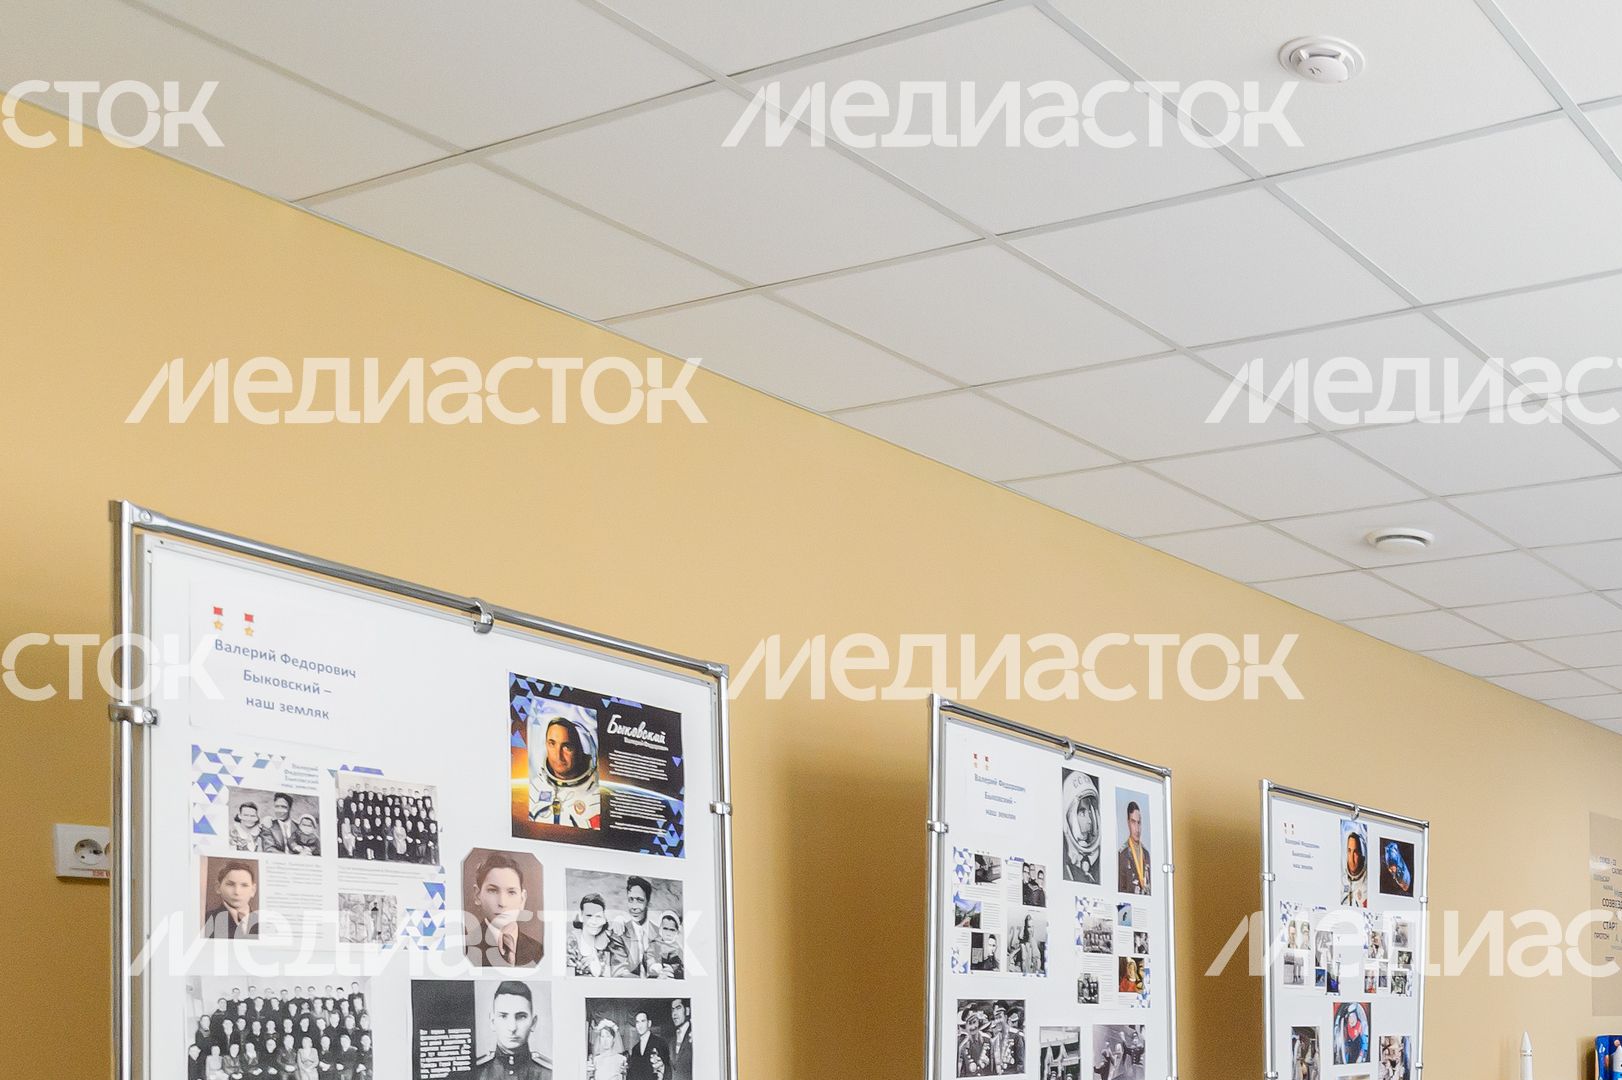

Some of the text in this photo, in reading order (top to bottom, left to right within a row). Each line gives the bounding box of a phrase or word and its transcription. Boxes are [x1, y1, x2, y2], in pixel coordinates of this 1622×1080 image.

[214, 638, 357, 679] Валерий Федорович
[243, 669, 321, 695] Быковский
[246, 696, 330, 720] наш земляк
[606, 713, 666, 745] Быковский
